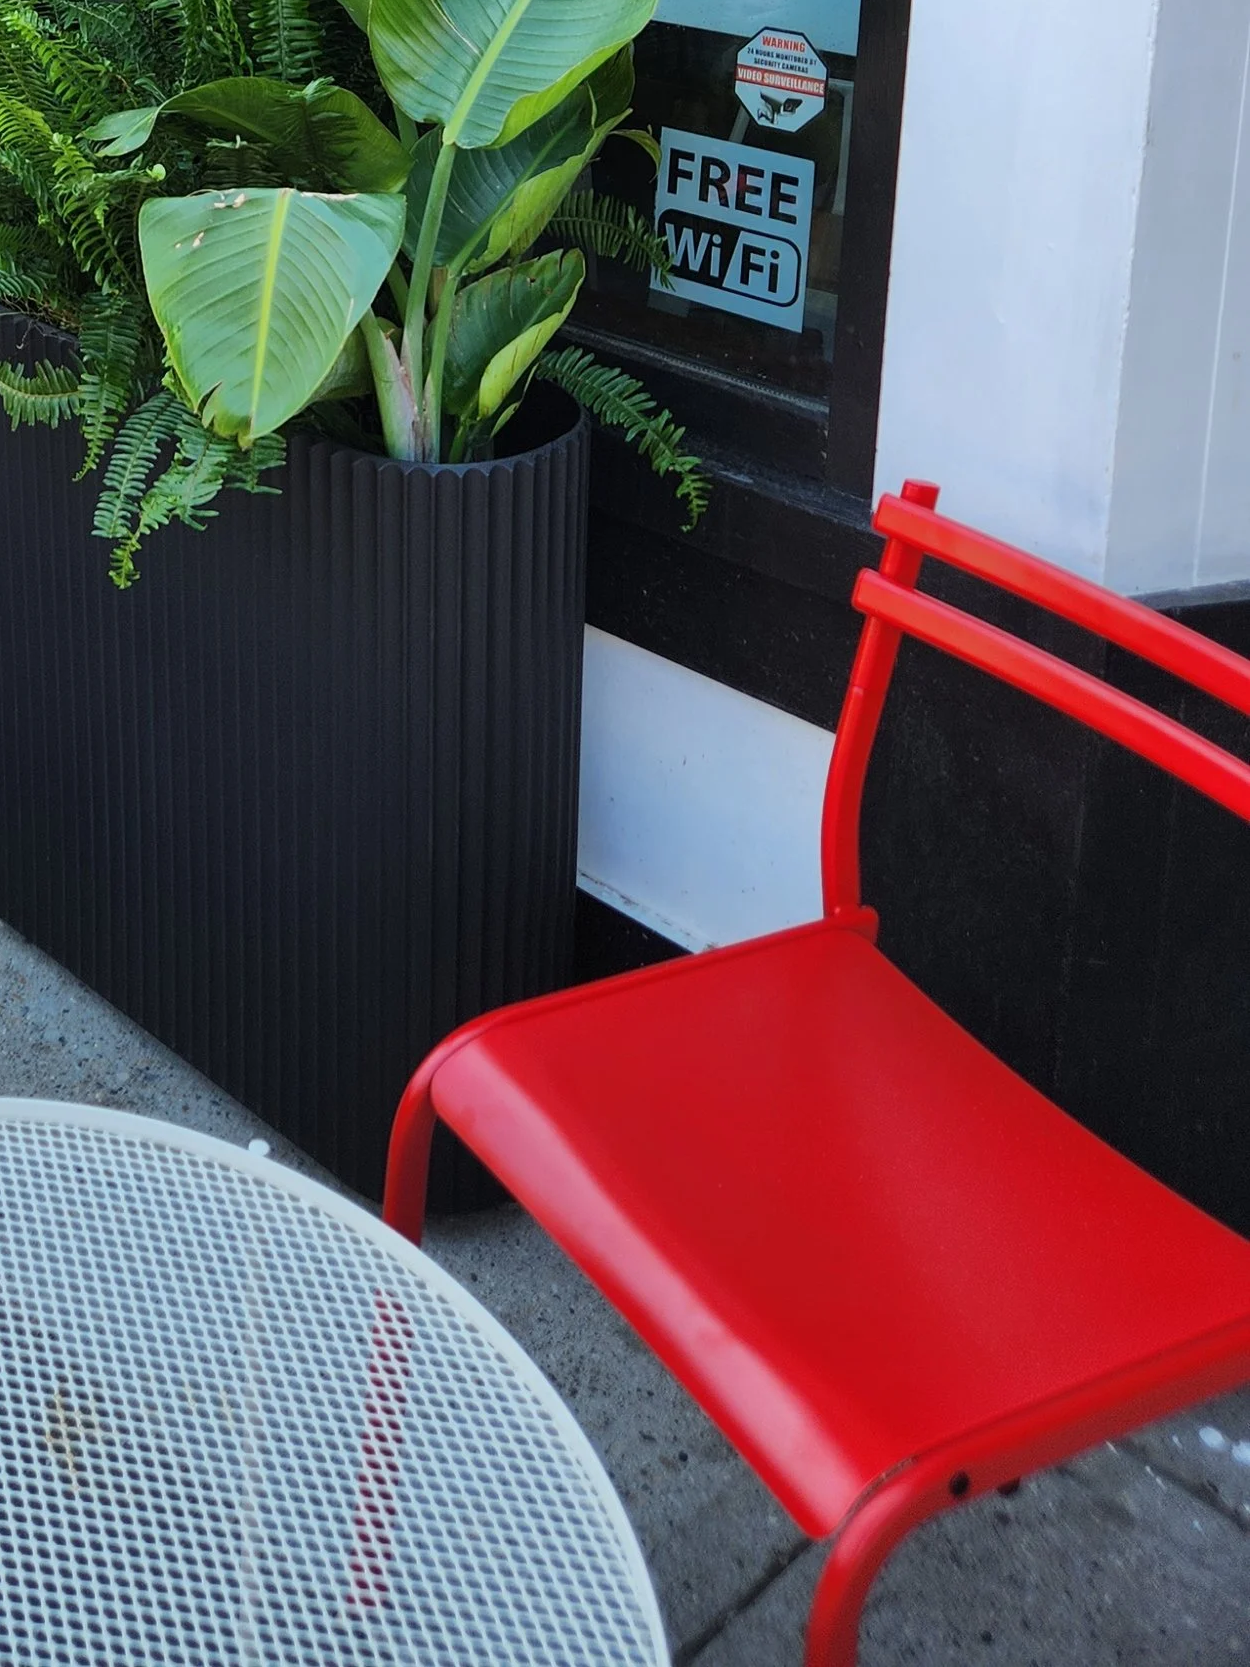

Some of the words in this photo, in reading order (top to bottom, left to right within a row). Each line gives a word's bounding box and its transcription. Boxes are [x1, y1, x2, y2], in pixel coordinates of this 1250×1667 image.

[762, 36, 806, 53] WARNING
[754, 57, 781, 69] SECURITY
[781, 63, 809, 74] CAMERAS
[737, 67, 762, 81] VIDEO
[763, 72, 825, 94] SURVEILLANCE
[666, 148, 801, 225] FREE
